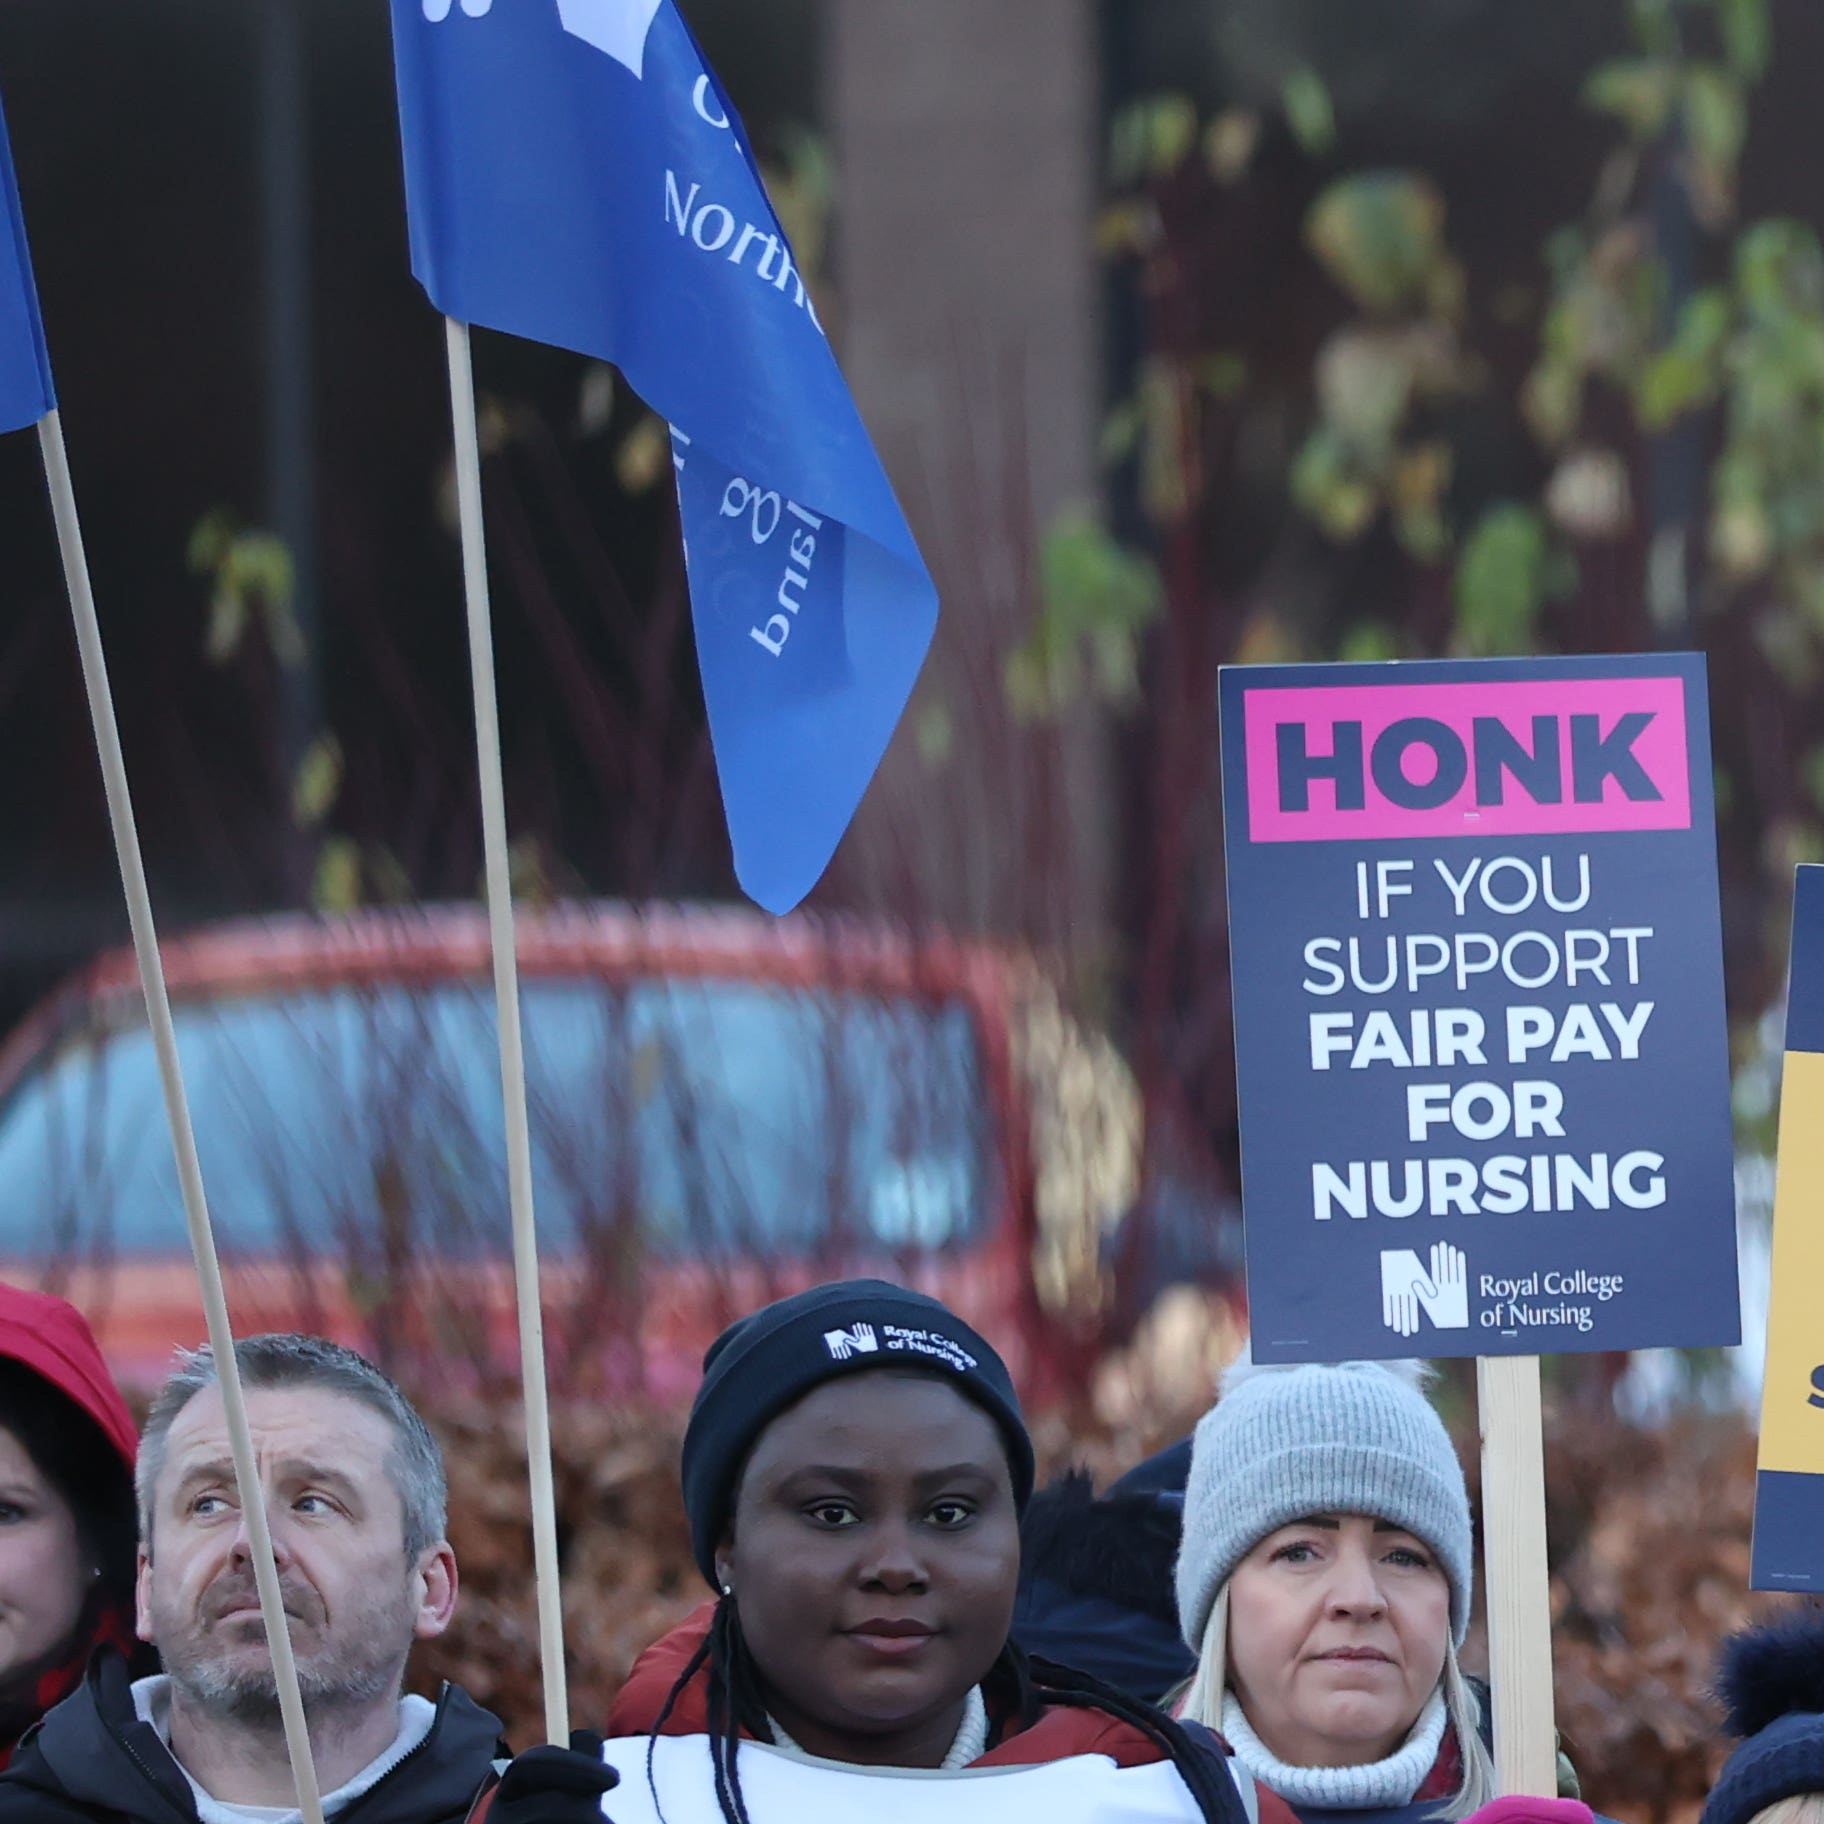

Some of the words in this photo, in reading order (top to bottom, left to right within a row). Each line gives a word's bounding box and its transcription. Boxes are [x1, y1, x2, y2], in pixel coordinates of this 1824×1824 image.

[1275, 712, 1665, 812] HONK
[1357, 860, 1413, 918] IF
[1434, 854, 1591, 915] YOU
[1303, 927, 1653, 995] SUPPORT
[1309, 1008, 1487, 1071] FAIR
[1506, 1002, 1655, 1064] PAY
[1408, 1080, 1566, 1142] FOR
[1312, 1150, 1667, 1221] NURSING
[1480, 1273, 1539, 1306] Royal
[1544, 1269, 1623, 1300] College
[1480, 1303, 1503, 1328] of
[1508, 1298, 1594, 1331] Nursing
[883, 1325, 927, 1342] Royal
